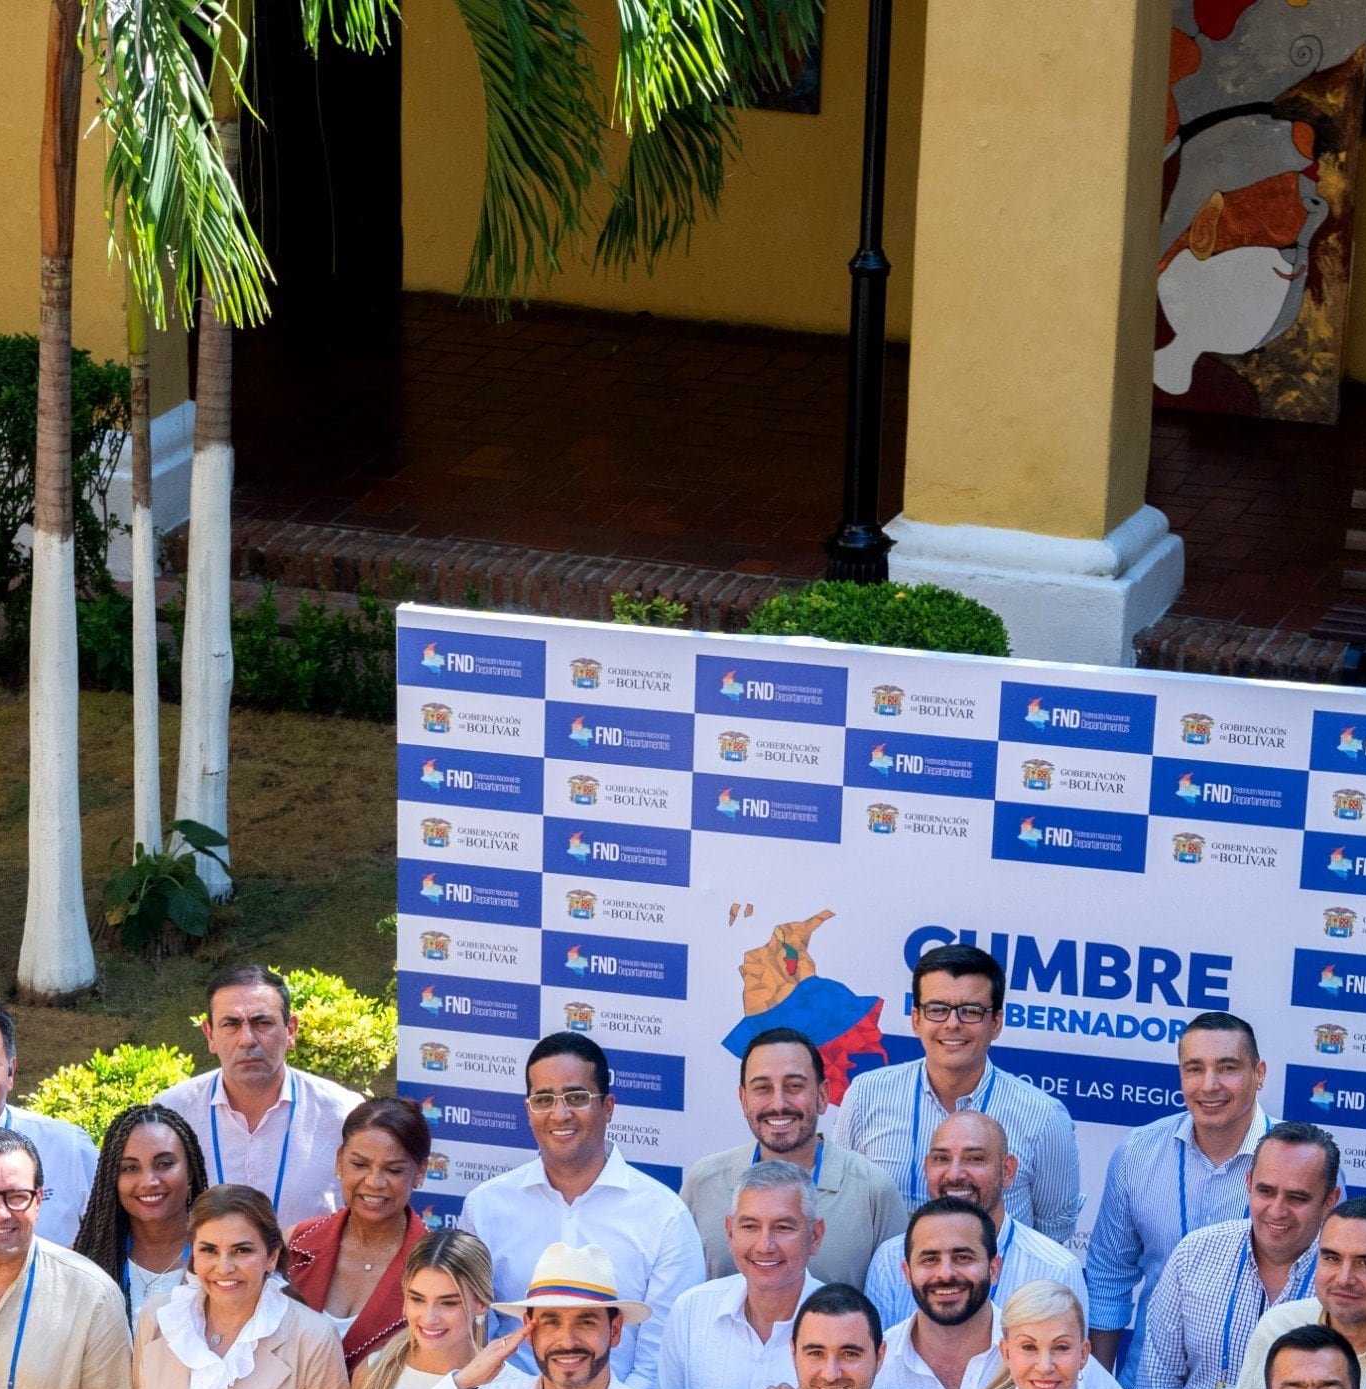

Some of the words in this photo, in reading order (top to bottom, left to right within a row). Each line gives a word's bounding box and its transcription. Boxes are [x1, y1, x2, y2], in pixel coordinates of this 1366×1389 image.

[447, 652, 474, 673] FND
[475, 664, 522, 677] Departamentos
[607, 666, 671, 679] GOBERNACIÓN
[615, 677, 670, 691] BOLÍVAR
[745, 679, 773, 700] FND
[774, 691, 822, 705] Departamentos
[909, 694, 975, 707] GOBERNACIÓN
[458, 711, 521, 724] GOBERNACIÓN
[917, 704, 974, 719] BOLÍVAR
[1051, 707, 1080, 729] FND
[466, 722, 520, 736] BOLÍVAR
[1080, 719, 1129, 733] Departamentos
[1219, 722, 1286, 735] GOBERNACIÓN
[594, 724, 622, 745] FND
[1227, 733, 1285, 748] BOLÍVAR
[623, 736, 670, 750] Departamentos
[755, 739, 820, 752] GOBERNACIÓN
[764, 750, 819, 764] BOLÍVAR
[895, 752, 923, 774] FND
[924, 764, 972, 778] Departamentos
[1060, 768, 1126, 781] GOBERNACIÓN
[446, 769, 473, 789] FND
[1068, 778, 1125, 793] BOLÍVAR
[474, 780, 520, 794] Departamentos
[604, 784, 668, 796] GOBERNACIÓN
[1202, 781, 1232, 803] FND
[613, 794, 667, 808] BOLÍVAR
[1232, 793, 1282, 807] Departamentos
[742, 797, 770, 818] FND
[770, 809, 818, 822] Departamentos
[904, 812, 969, 825] GOBERNACIÓN
[457, 827, 519, 840] GOBERNACIÓN
[912, 823, 968, 837] BOLÍVAR
[1044, 826, 1073, 847] FND
[465, 837, 519, 851] BOLÍVAR
[592, 840, 619, 861] FND
[1074, 838, 1122, 852] Departamentos
[1211, 842, 1277, 855] GOBERNACIÓN
[620, 852, 667, 866] Departamentos
[1219, 852, 1276, 867] BOLÍVAR
[446, 883, 472, 903] FND
[473, 895, 519, 908] Departamentos
[602, 899, 665, 911] GOBERNACIÓN
[611, 909, 664, 923] BOLÍVAR
[456, 940, 518, 953] GOBERNACIÓN
[465, 950, 517, 965] BOLÍVAR
[590, 954, 617, 975] FND
[618, 966, 664, 980] Departamentos
[445, 995, 471, 1016] FND
[472, 1007, 518, 1020] Departamentos
[600, 1012, 662, 1025] GOBERNACIÓN
[609, 1022, 662, 1036] BOLÍVAR
[455, 1052, 516, 1065] GOBERNACIÓN
[464, 1062, 516, 1076] BOLÍVAR
[1040, 1076, 1069, 1095] DE
[1075, 1079, 1114, 1100] LAS
[1121, 1084, 1186, 1107] REGIO
[1336, 1089, 1366, 1110] FND
[444, 1106, 470, 1126] FND
[606, 1123, 660, 1135] OBERNACIÓN
[607, 1131, 659, 1146] BOLÍVAR
